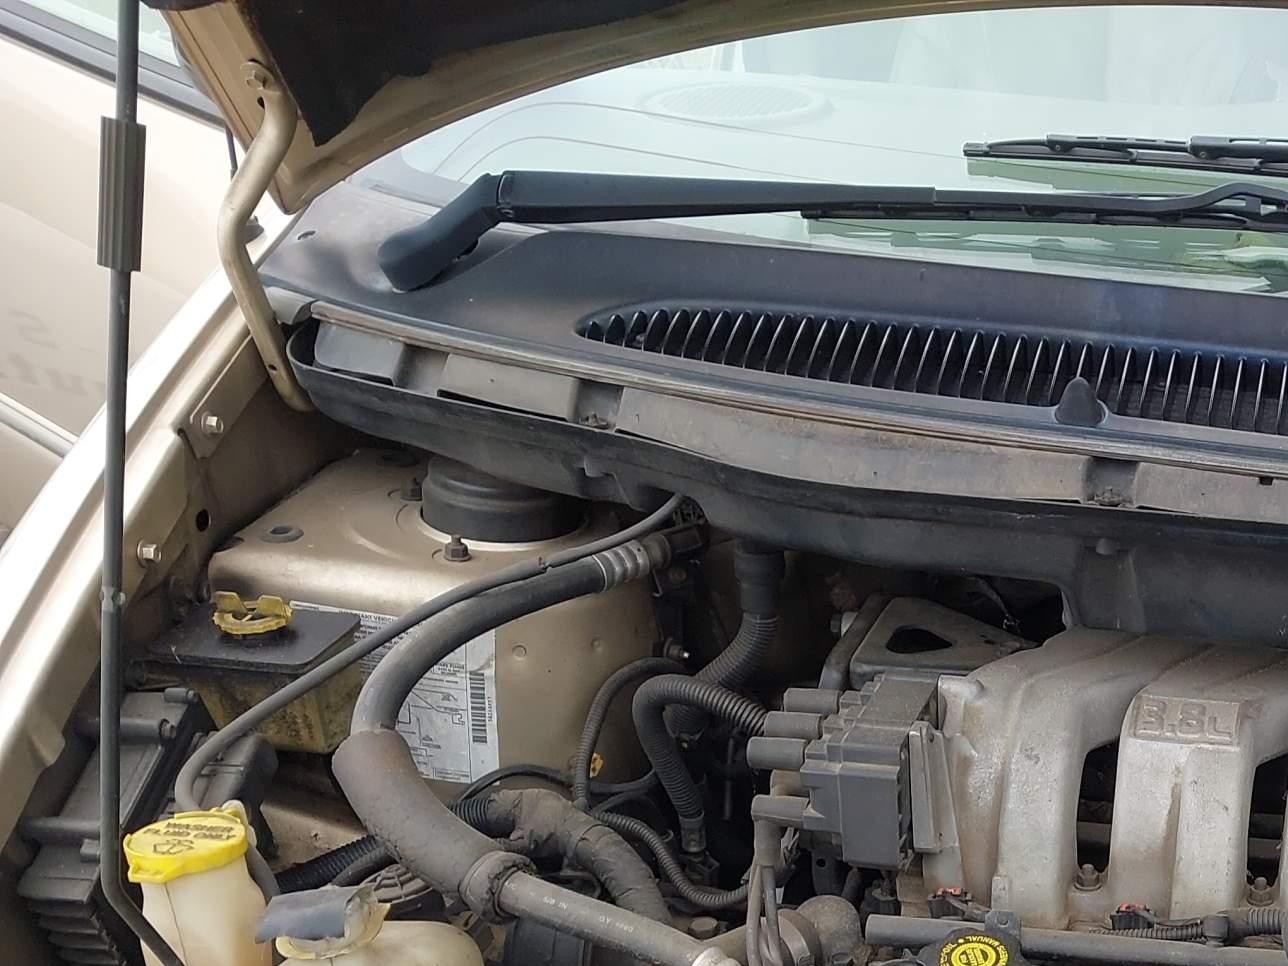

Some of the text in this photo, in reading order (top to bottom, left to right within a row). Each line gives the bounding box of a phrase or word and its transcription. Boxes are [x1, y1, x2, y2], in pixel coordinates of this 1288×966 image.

[1134, 698, 1233, 738] 3.8L
[164, 822, 235, 833] WASHER
[142, 828, 236, 840] FLUID ONLY
[965, 935, 1001, 947] MANUAL
